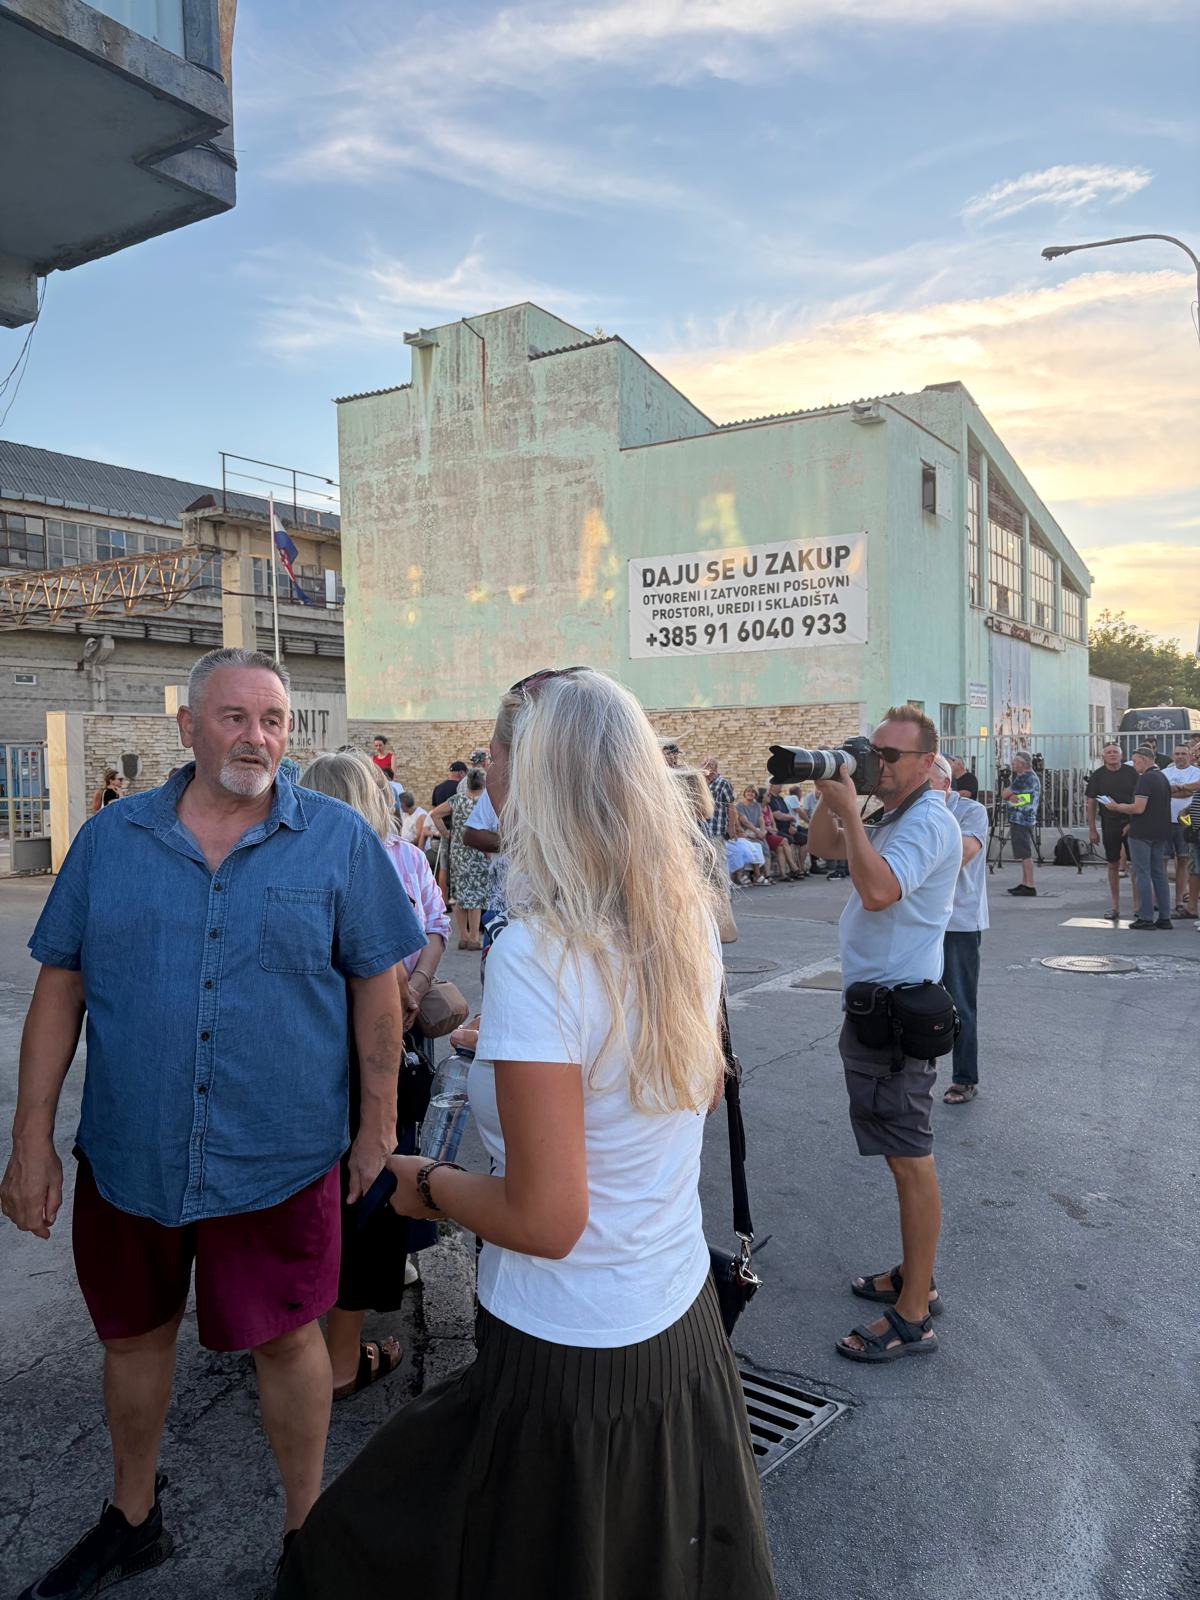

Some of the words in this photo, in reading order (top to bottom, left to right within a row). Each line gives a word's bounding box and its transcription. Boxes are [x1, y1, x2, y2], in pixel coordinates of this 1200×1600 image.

[642, 563, 699, 588] DAJU
[706, 559, 735, 582] SE
[743, 555, 758, 578] U
[765, 545, 851, 576] ZAKUP
[643, 590, 700, 605] OTVORENI
[711, 582, 780, 600] ZATVORENI
[784, 575, 850, 593] POSLOVNI
[652, 605, 713, 620] PROSTORI,
[717, 601, 754, 615] UREDI
[765, 591, 839, 610] SKLADIŠTA
[646, 625, 697, 647] +385
[704, 623, 728, 644] 91
[737, 616, 794, 642] 6040
[802, 612, 847, 636] 933
